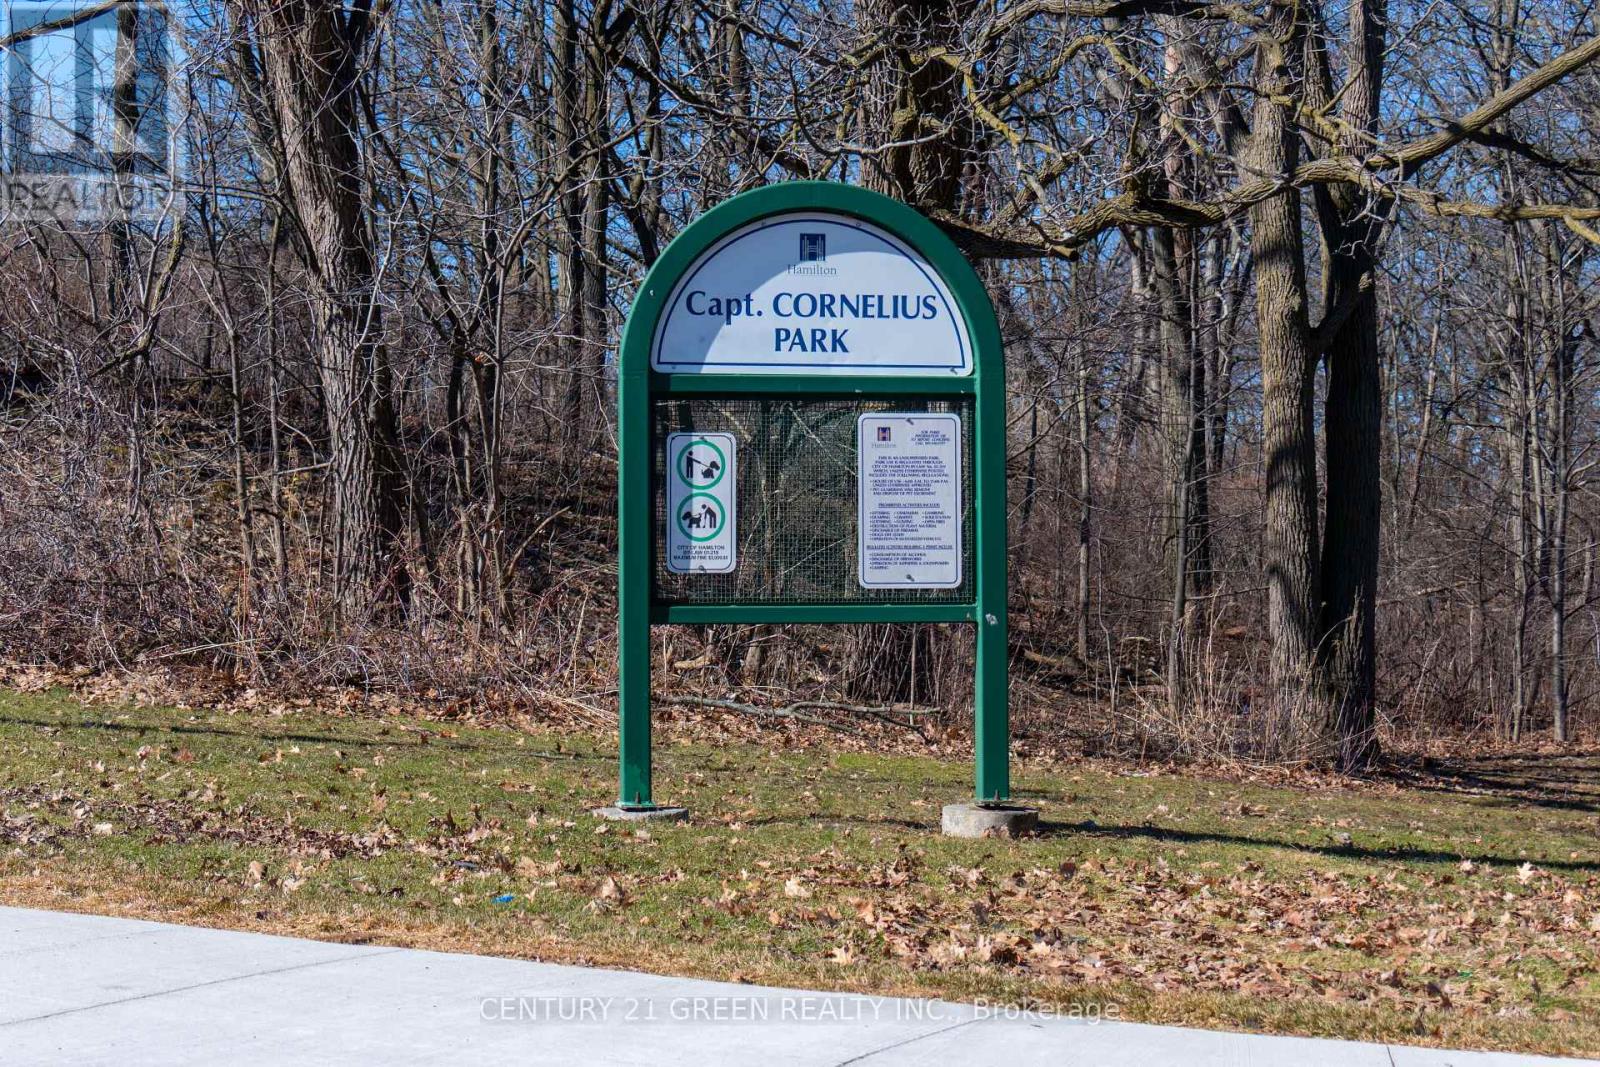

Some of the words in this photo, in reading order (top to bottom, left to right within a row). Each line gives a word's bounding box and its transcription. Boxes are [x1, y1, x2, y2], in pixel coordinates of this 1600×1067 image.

[787, 264, 837, 276] Hamilton
[686, 291, 763, 326] Capt.
[772, 292, 938, 320] CORNELIUS
[774, 328, 850, 353] PARK
